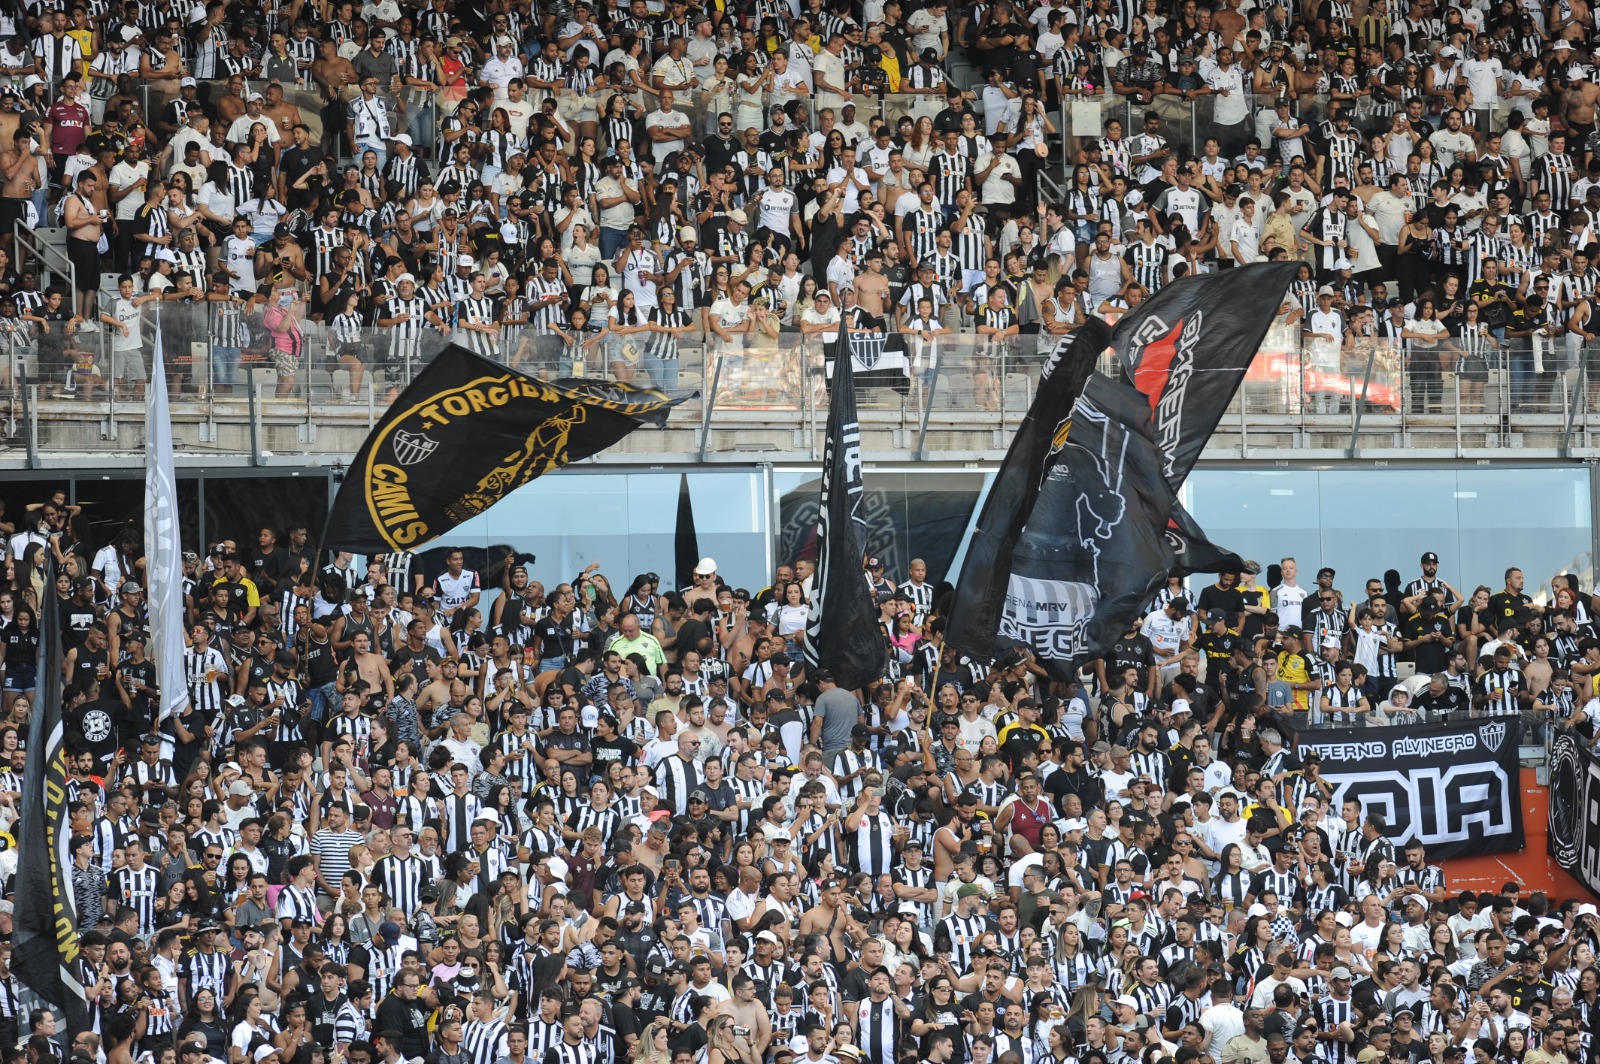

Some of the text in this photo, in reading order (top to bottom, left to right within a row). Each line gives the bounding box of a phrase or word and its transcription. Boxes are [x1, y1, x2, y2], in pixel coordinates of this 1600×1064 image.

[60, 119, 84, 128] CAIXA
[853, 332, 883, 340] CAM
[401, 434, 433, 449] CAM
[1036, 602, 1067, 612] MRV
[89, 718, 104, 733] 13
[1298, 733, 1477, 762] INFERNO ALVINEGRO
